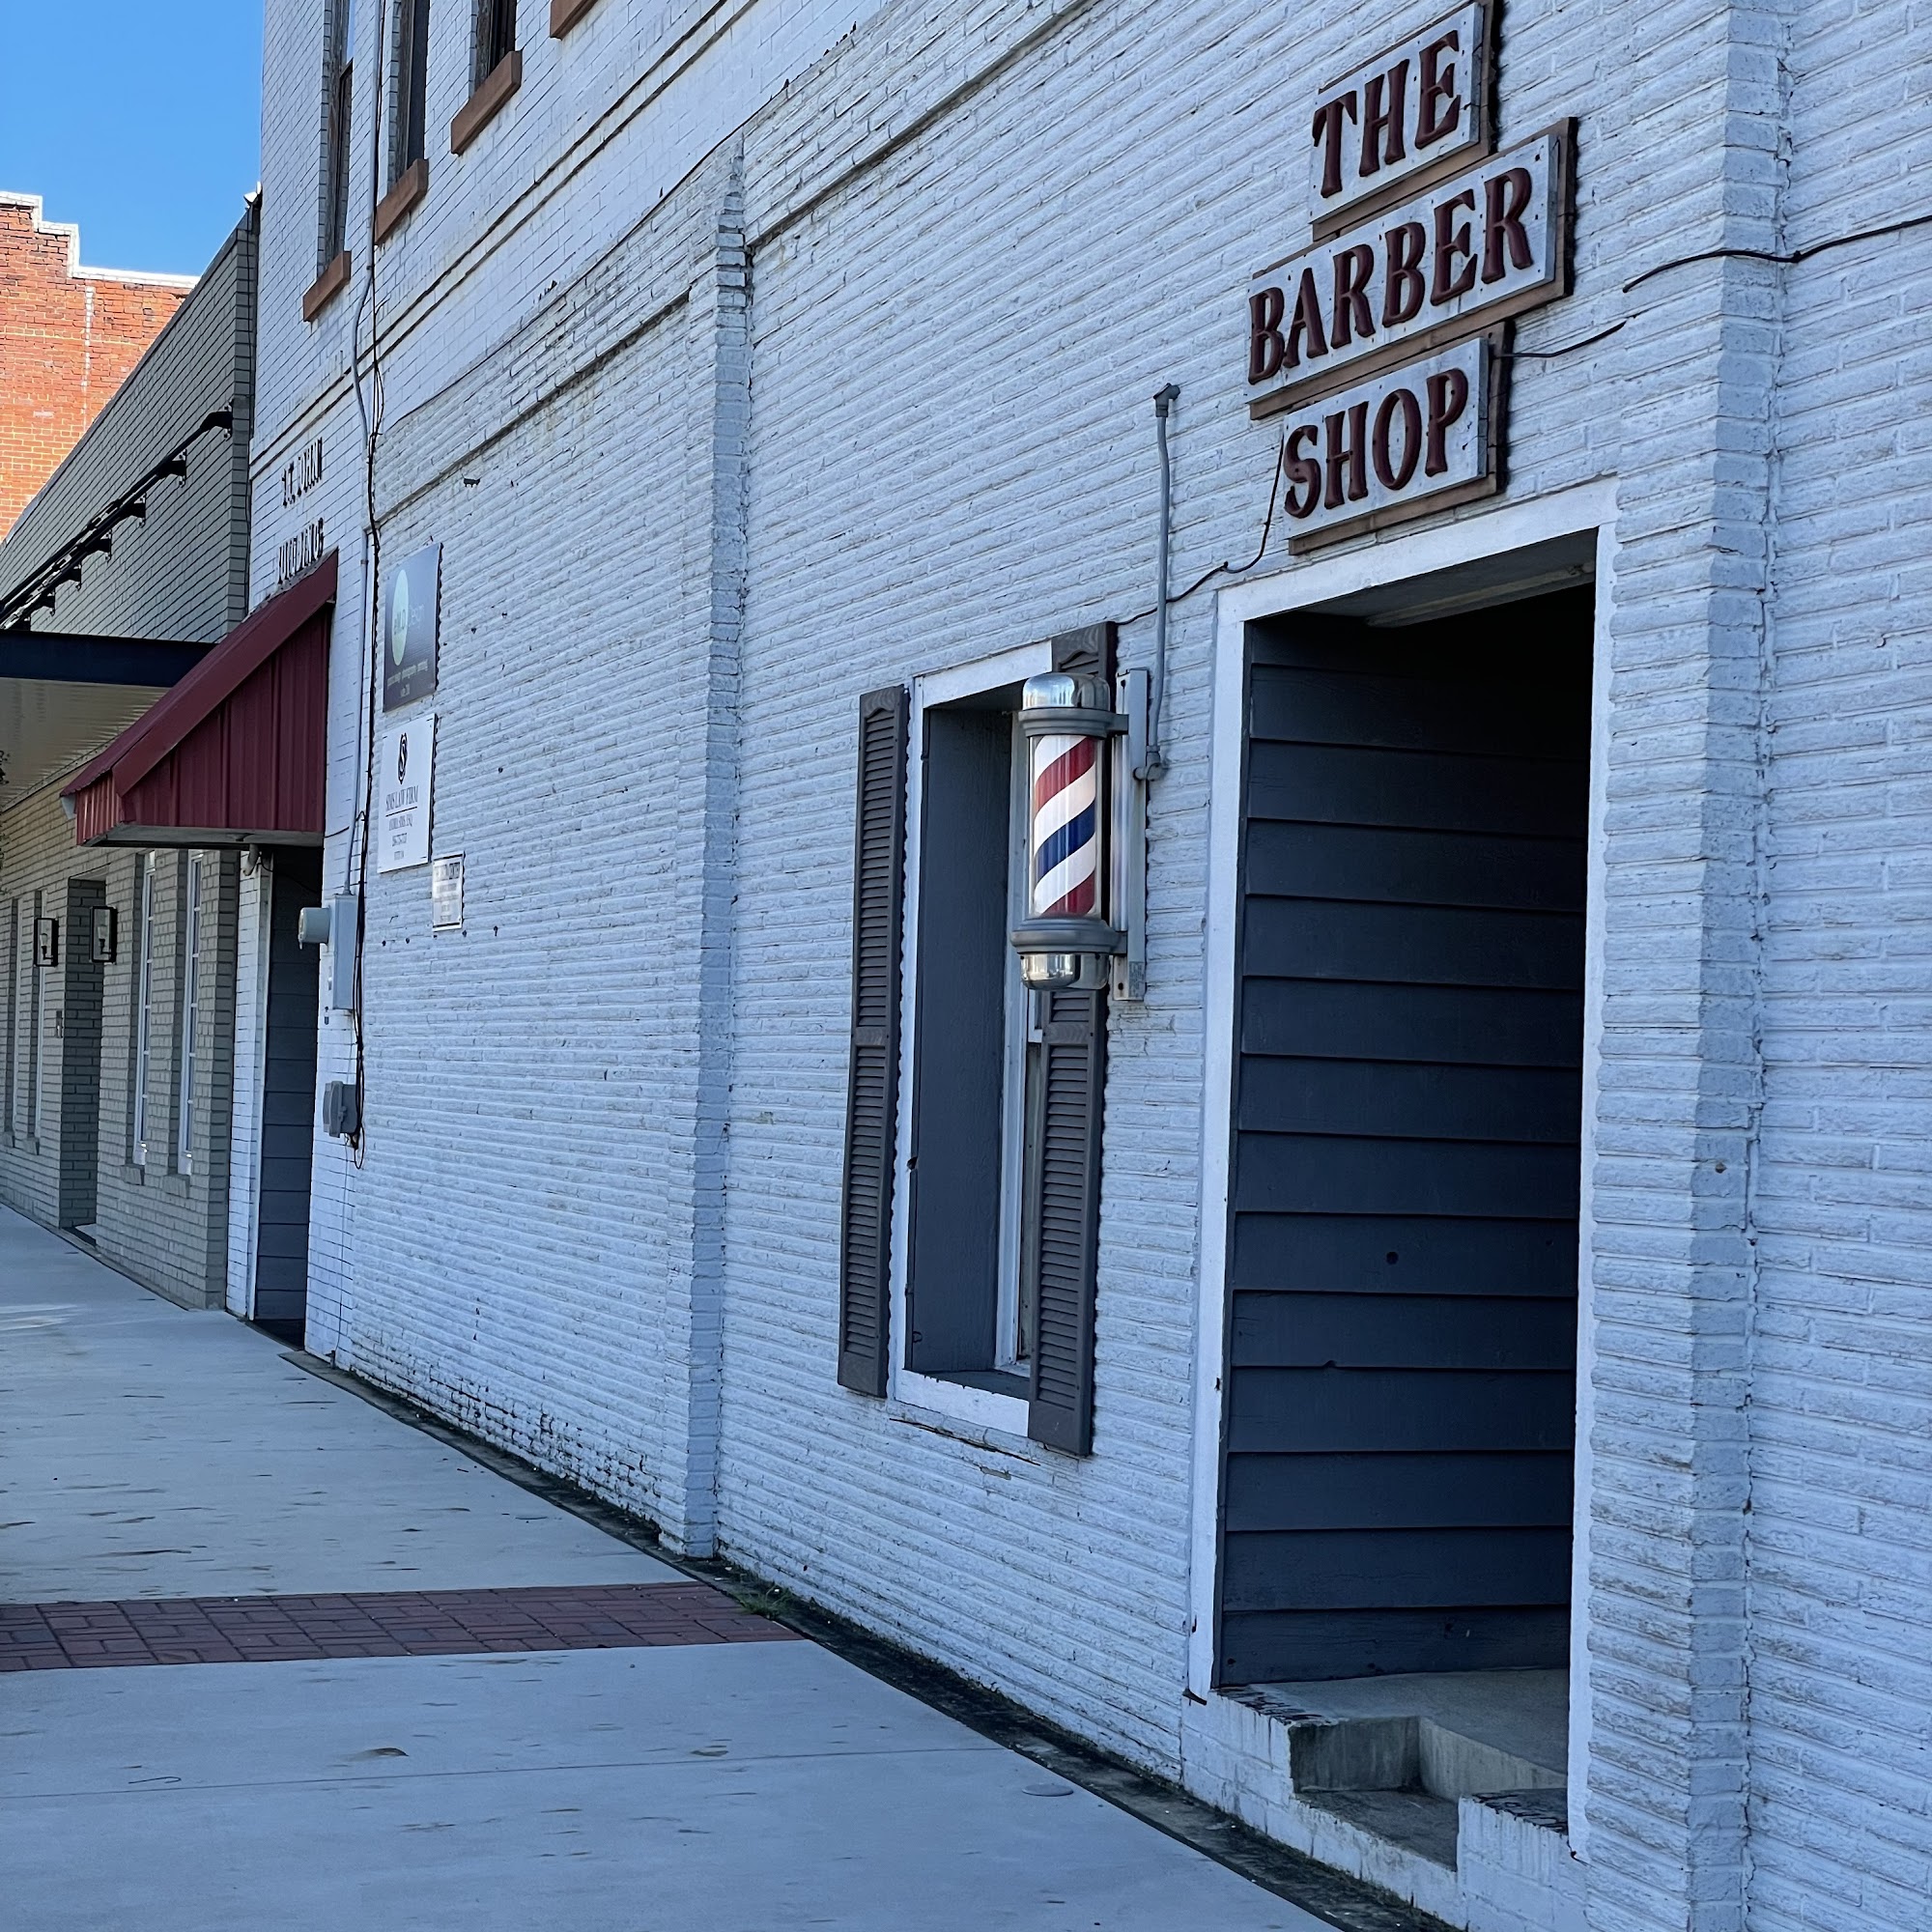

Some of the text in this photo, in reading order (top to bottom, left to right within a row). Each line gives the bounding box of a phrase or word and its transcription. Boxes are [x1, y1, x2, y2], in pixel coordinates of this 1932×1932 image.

[1312, 30, 1460, 198] THE
[1248, 167, 1533, 385] BARBER
[298, 437, 323, 497] JOHN
[1284, 368, 1467, 519] SHOP
